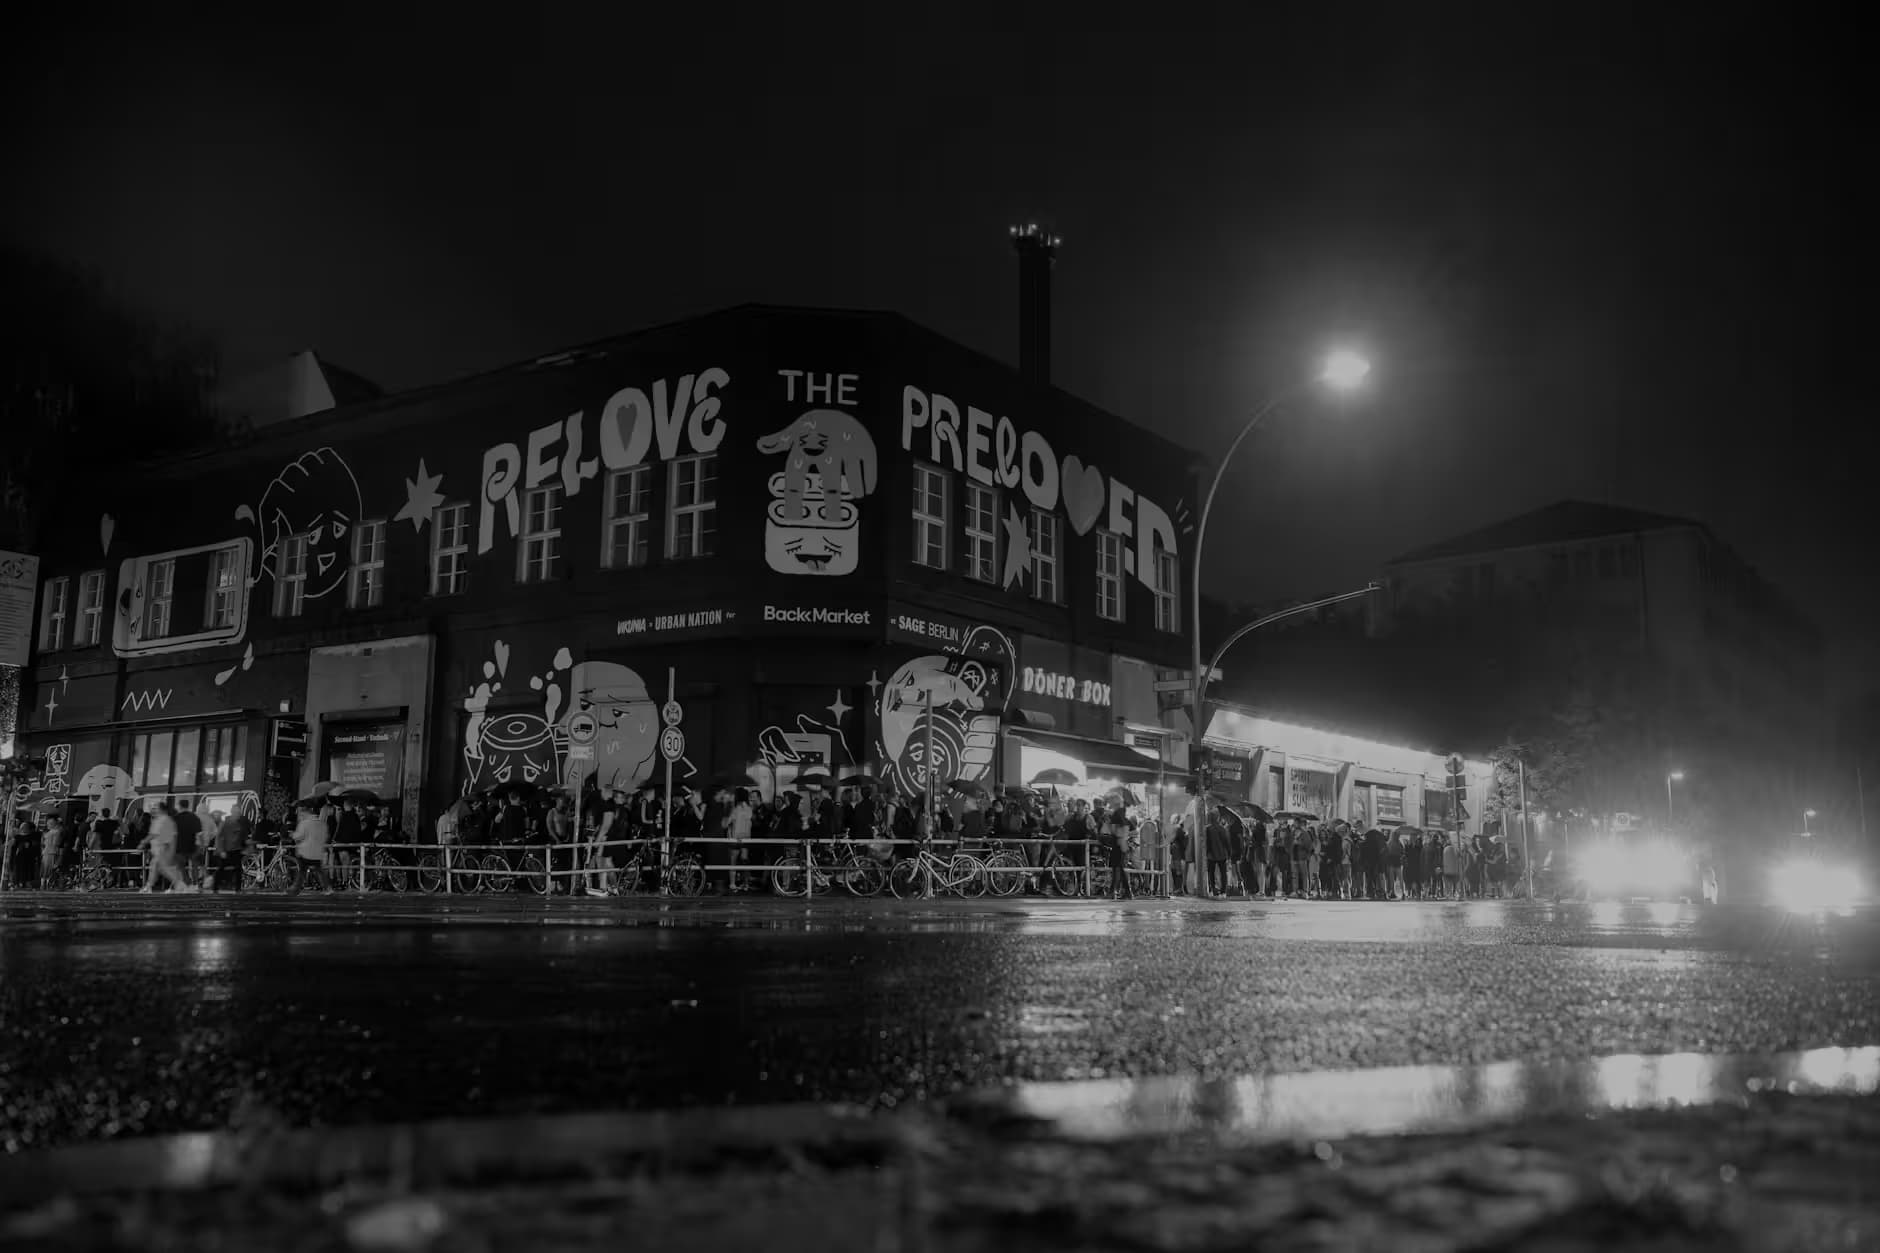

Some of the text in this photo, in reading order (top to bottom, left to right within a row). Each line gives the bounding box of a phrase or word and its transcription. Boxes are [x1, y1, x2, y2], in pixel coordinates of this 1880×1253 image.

[777, 369, 861, 406] THE
[478, 367, 730, 556] RELOVE
[655, 613, 686, 631] URBAN
[688, 609, 722, 627] NATION
[764, 605, 871, 625] Back Market
[898, 615, 926, 634] SAGE
[928, 622, 959, 641] BERLIN
[1023, 666, 1111, 706] DÖNER BOX
[666, 736, 679, 751] 30
